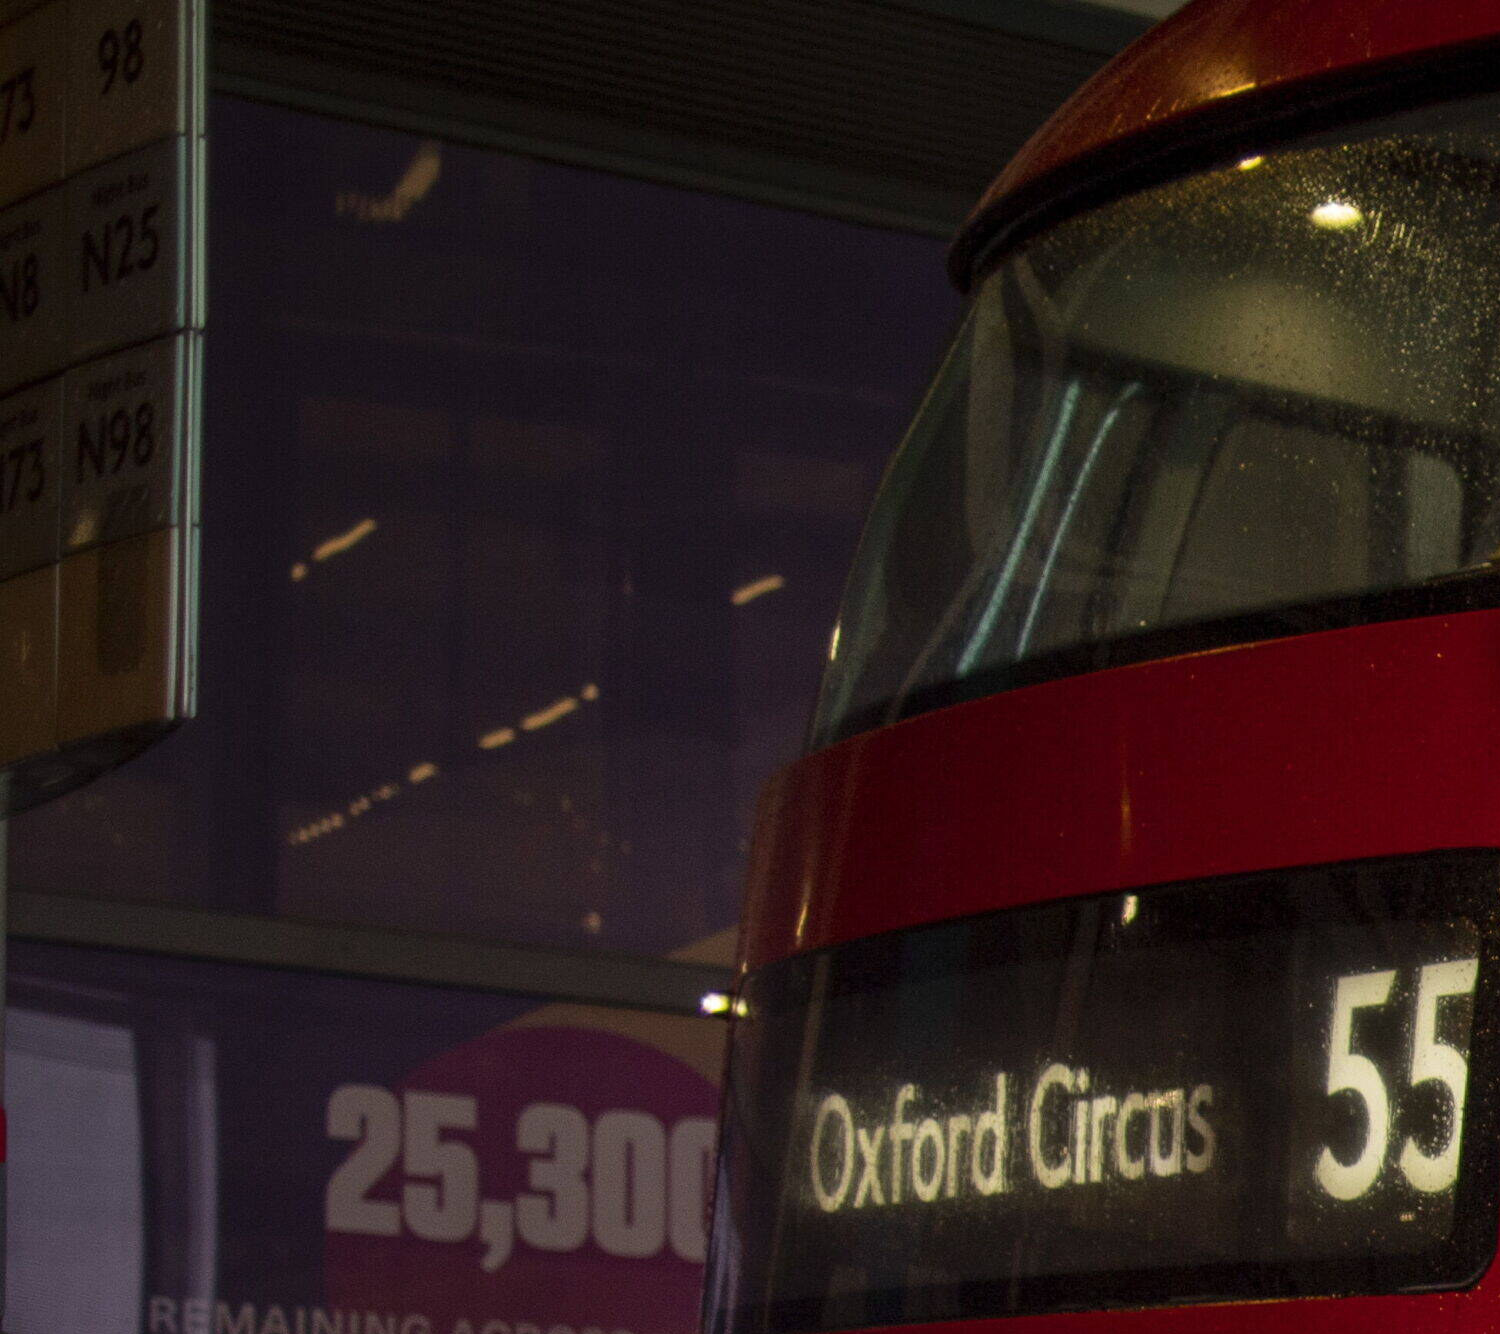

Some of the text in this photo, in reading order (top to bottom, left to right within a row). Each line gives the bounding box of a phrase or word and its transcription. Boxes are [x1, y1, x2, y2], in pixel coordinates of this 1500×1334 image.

[98, 18, 145, 95] 98
[81, 203, 159, 292] N25
[0, 435, 45, 512] 73
[75, 402, 154, 485] N98
[1313, 957, 1480, 1201] 55
[810, 1062, 1217, 1213] Oxford Circus
